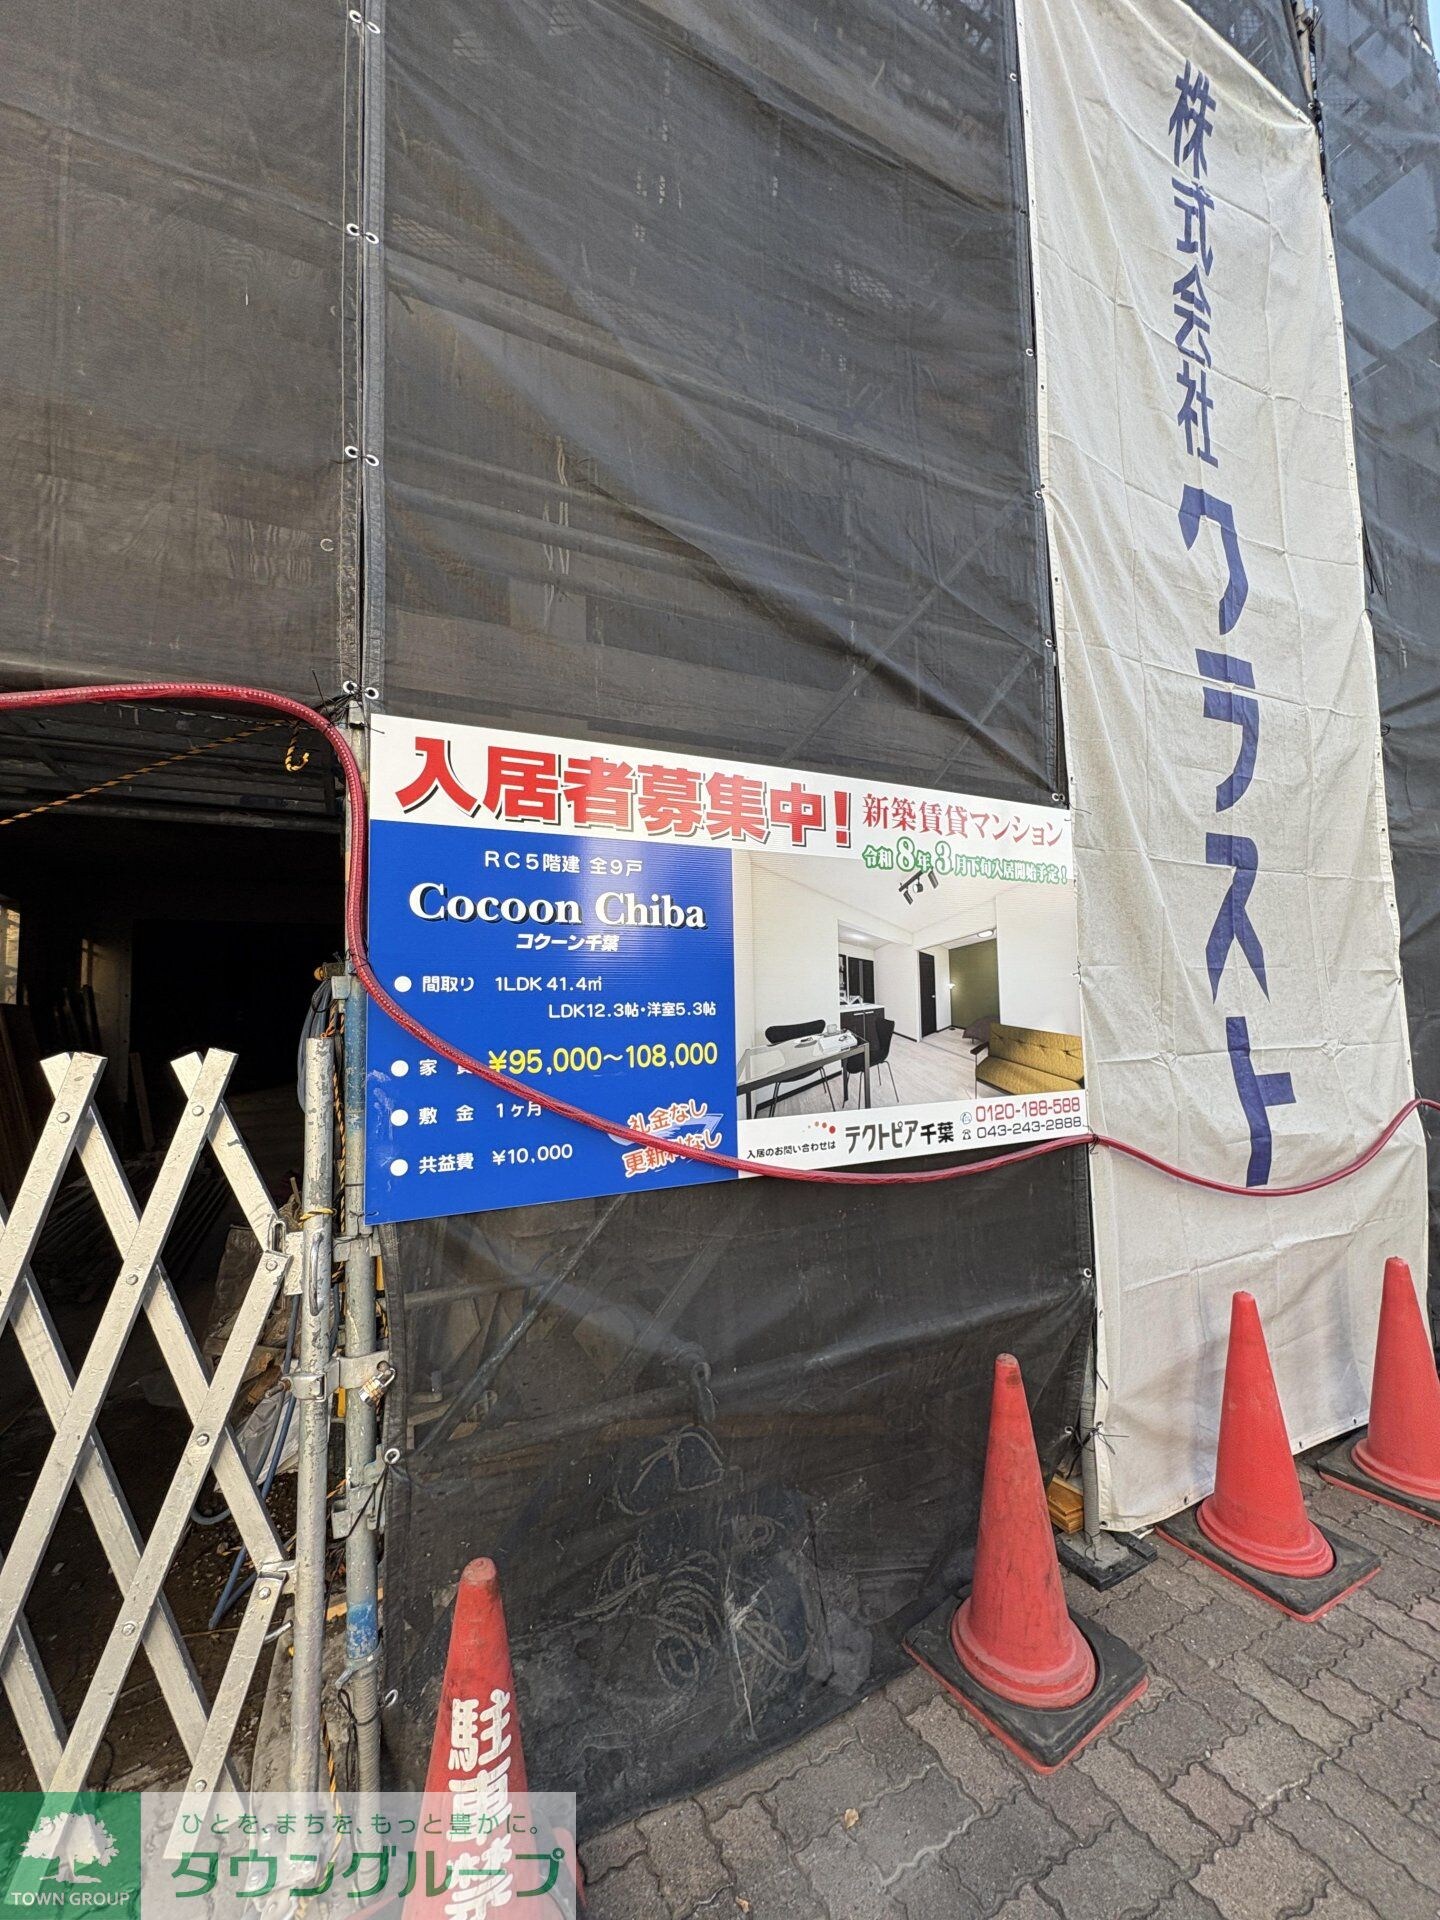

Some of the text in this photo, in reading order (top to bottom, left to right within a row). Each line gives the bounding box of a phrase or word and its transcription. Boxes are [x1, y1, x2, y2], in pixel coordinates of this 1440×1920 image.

[395, 735, 852, 849] 入居者募集中!
[861, 792, 1064, 848] 新築賃貸マンション
[589, 856, 643, 877] 全9戸
[408, 881, 708, 930] Cocoon Chiba
[515, 933, 620, 952] コクーン千葉
[421, 975, 476, 993] 間取り
[494, 976, 543, 992] 1LDK
[626, 1098, 709, 1134] 礼金なし
[975, 1096, 1081, 1123] 0120-188-588
[844, 1119, 955, 1154] テクトピア千葉
[975, 1116, 1083, 1139] 043-243-2888
[418, 1143, 574, 1175] 共益費 ¥10,000
[746, 1140, 837, 1160] 入居のお問い合わせは
